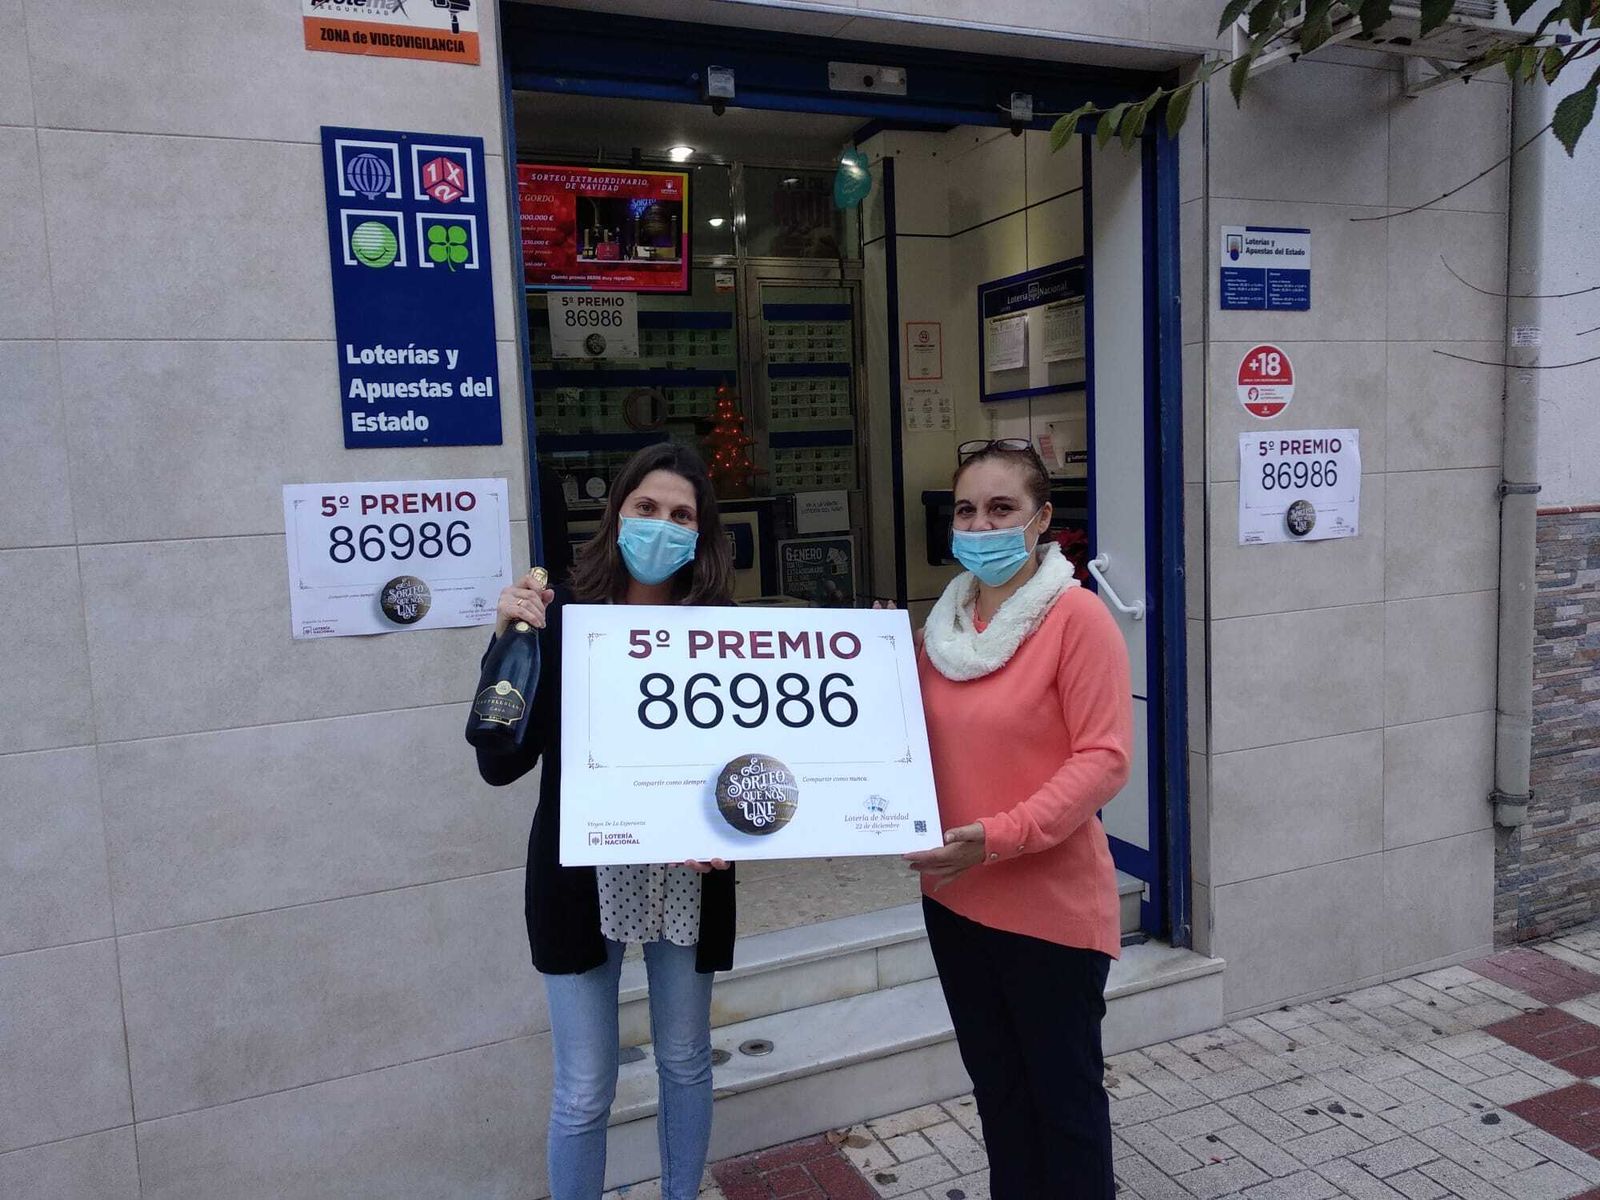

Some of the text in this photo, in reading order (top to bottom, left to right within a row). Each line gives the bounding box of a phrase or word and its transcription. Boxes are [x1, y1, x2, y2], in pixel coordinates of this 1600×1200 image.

[320, 27, 466, 53] ZONA de VIDEOVIGILANCIA
[531, 173, 649, 187] SORTEO EXTRAORDINARIO
[565, 182, 620, 192] DE NAVIDAD
[524, 193, 555, 203] GORDO
[1245, 247, 1306, 256] Apuestas del Estado
[1271, 239, 1276, 248] y
[577, 297, 625, 307] PREMIO
[565, 310, 623, 327] 86986
[346, 343, 459, 370] Loterías y
[1249, 352, 1282, 377] +18
[349, 376, 494, 404] Apuestas del
[351, 410, 429, 432] Estado
[1259, 438, 1342, 457] 5º PREMIO
[1261, 460, 1338, 490] 86986
[321, 490, 477, 518] 5º PREMIO
[329, 520, 472, 564] 86986
[387, 584, 424, 604] SORTEO
[393, 603, 418, 620] UNE
[628, 629, 862, 660] 5º PREMIO
[637, 672, 859, 729] 86986
[741, 757, 767, 776] EL
[633, 779, 665, 788] Compartir
[727, 770, 785, 798] SORTEO
[802, 776, 832, 784] Compartir
[742, 784, 786, 803] QUE NOS
[737, 801, 777, 827] UNE
[844, 812, 909, 822] Lotería de Navidad
[871, 821, 900, 829] diciembre
[604, 832, 633, 840] LOTERÍA
[604, 838, 640, 846] NACIONAL
